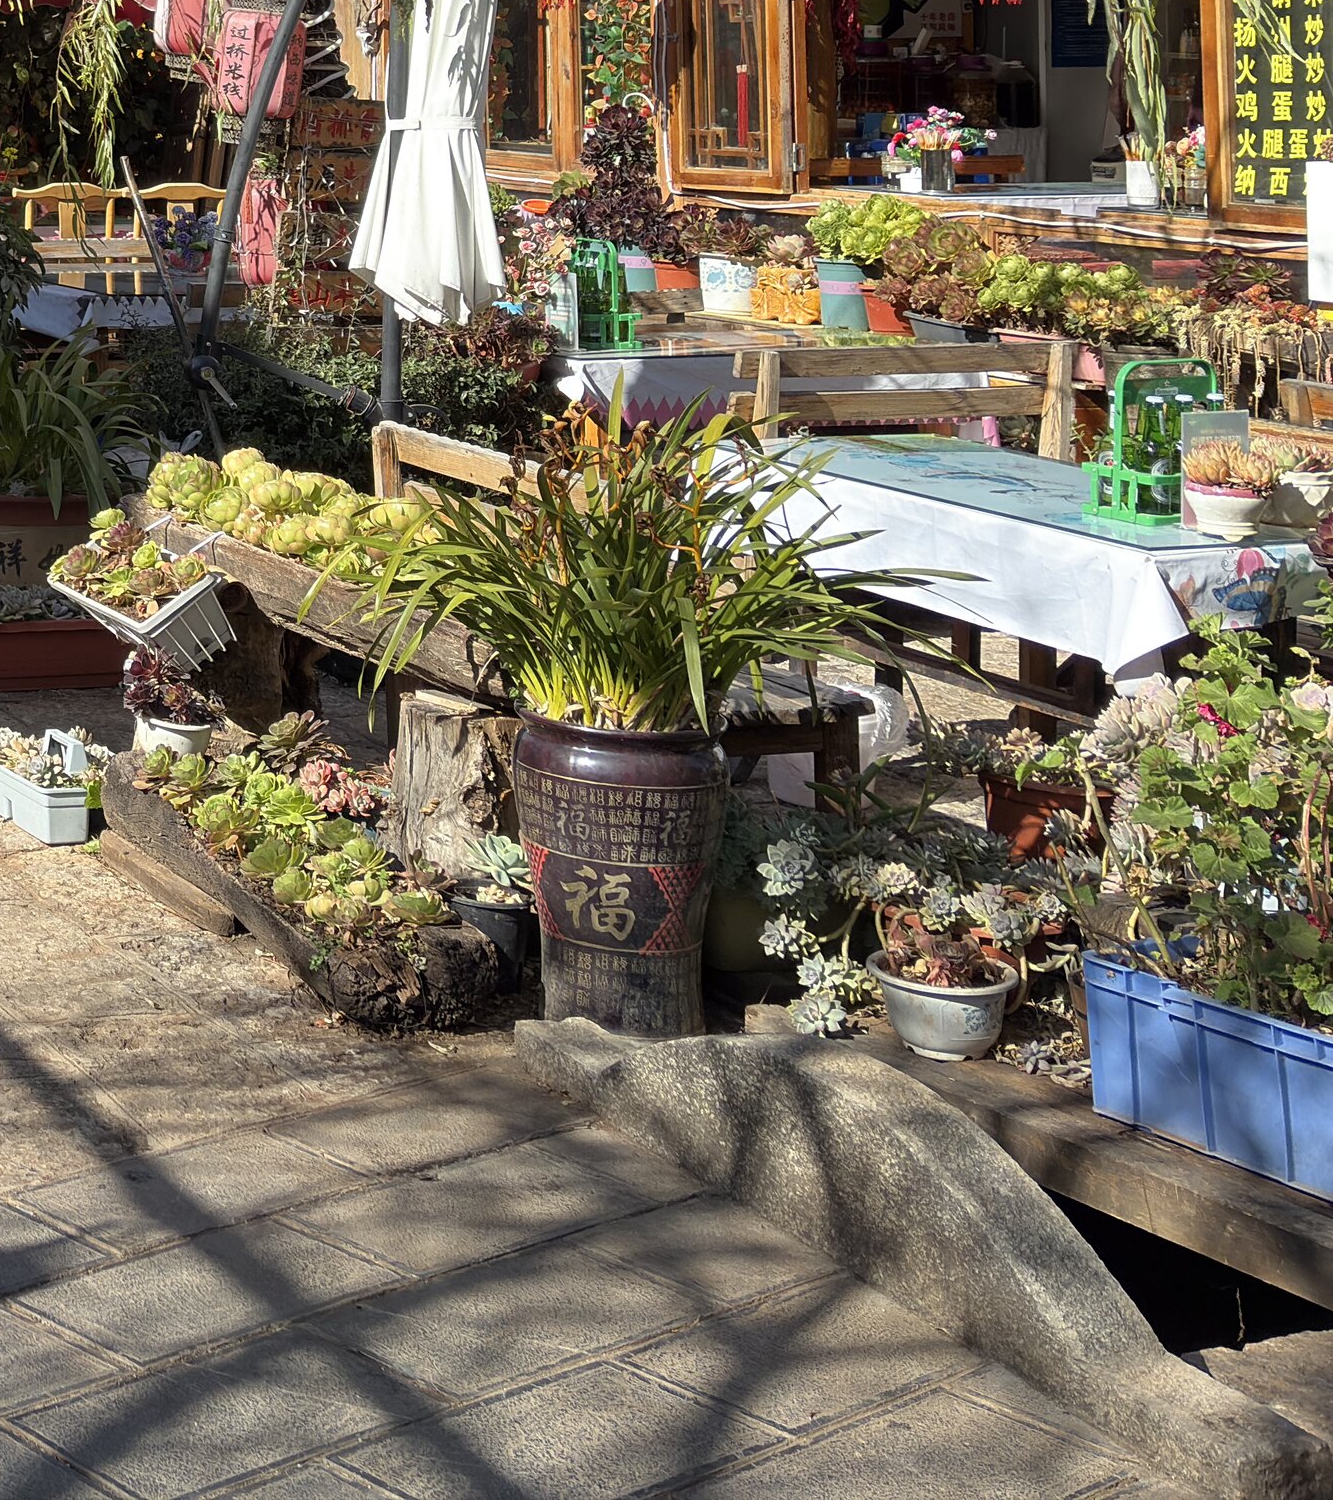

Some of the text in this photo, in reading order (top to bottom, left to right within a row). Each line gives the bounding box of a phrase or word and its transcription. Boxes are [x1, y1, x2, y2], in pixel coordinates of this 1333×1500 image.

[223, 25, 251, 100] 过桥米线
[1236, 52, 1325, 85] 火腿炒
[1236, 90, 1326, 122] 鸡蛋炒
[1235, 164, 1309, 196] 纳西
[559, 864, 636, 941] 福
